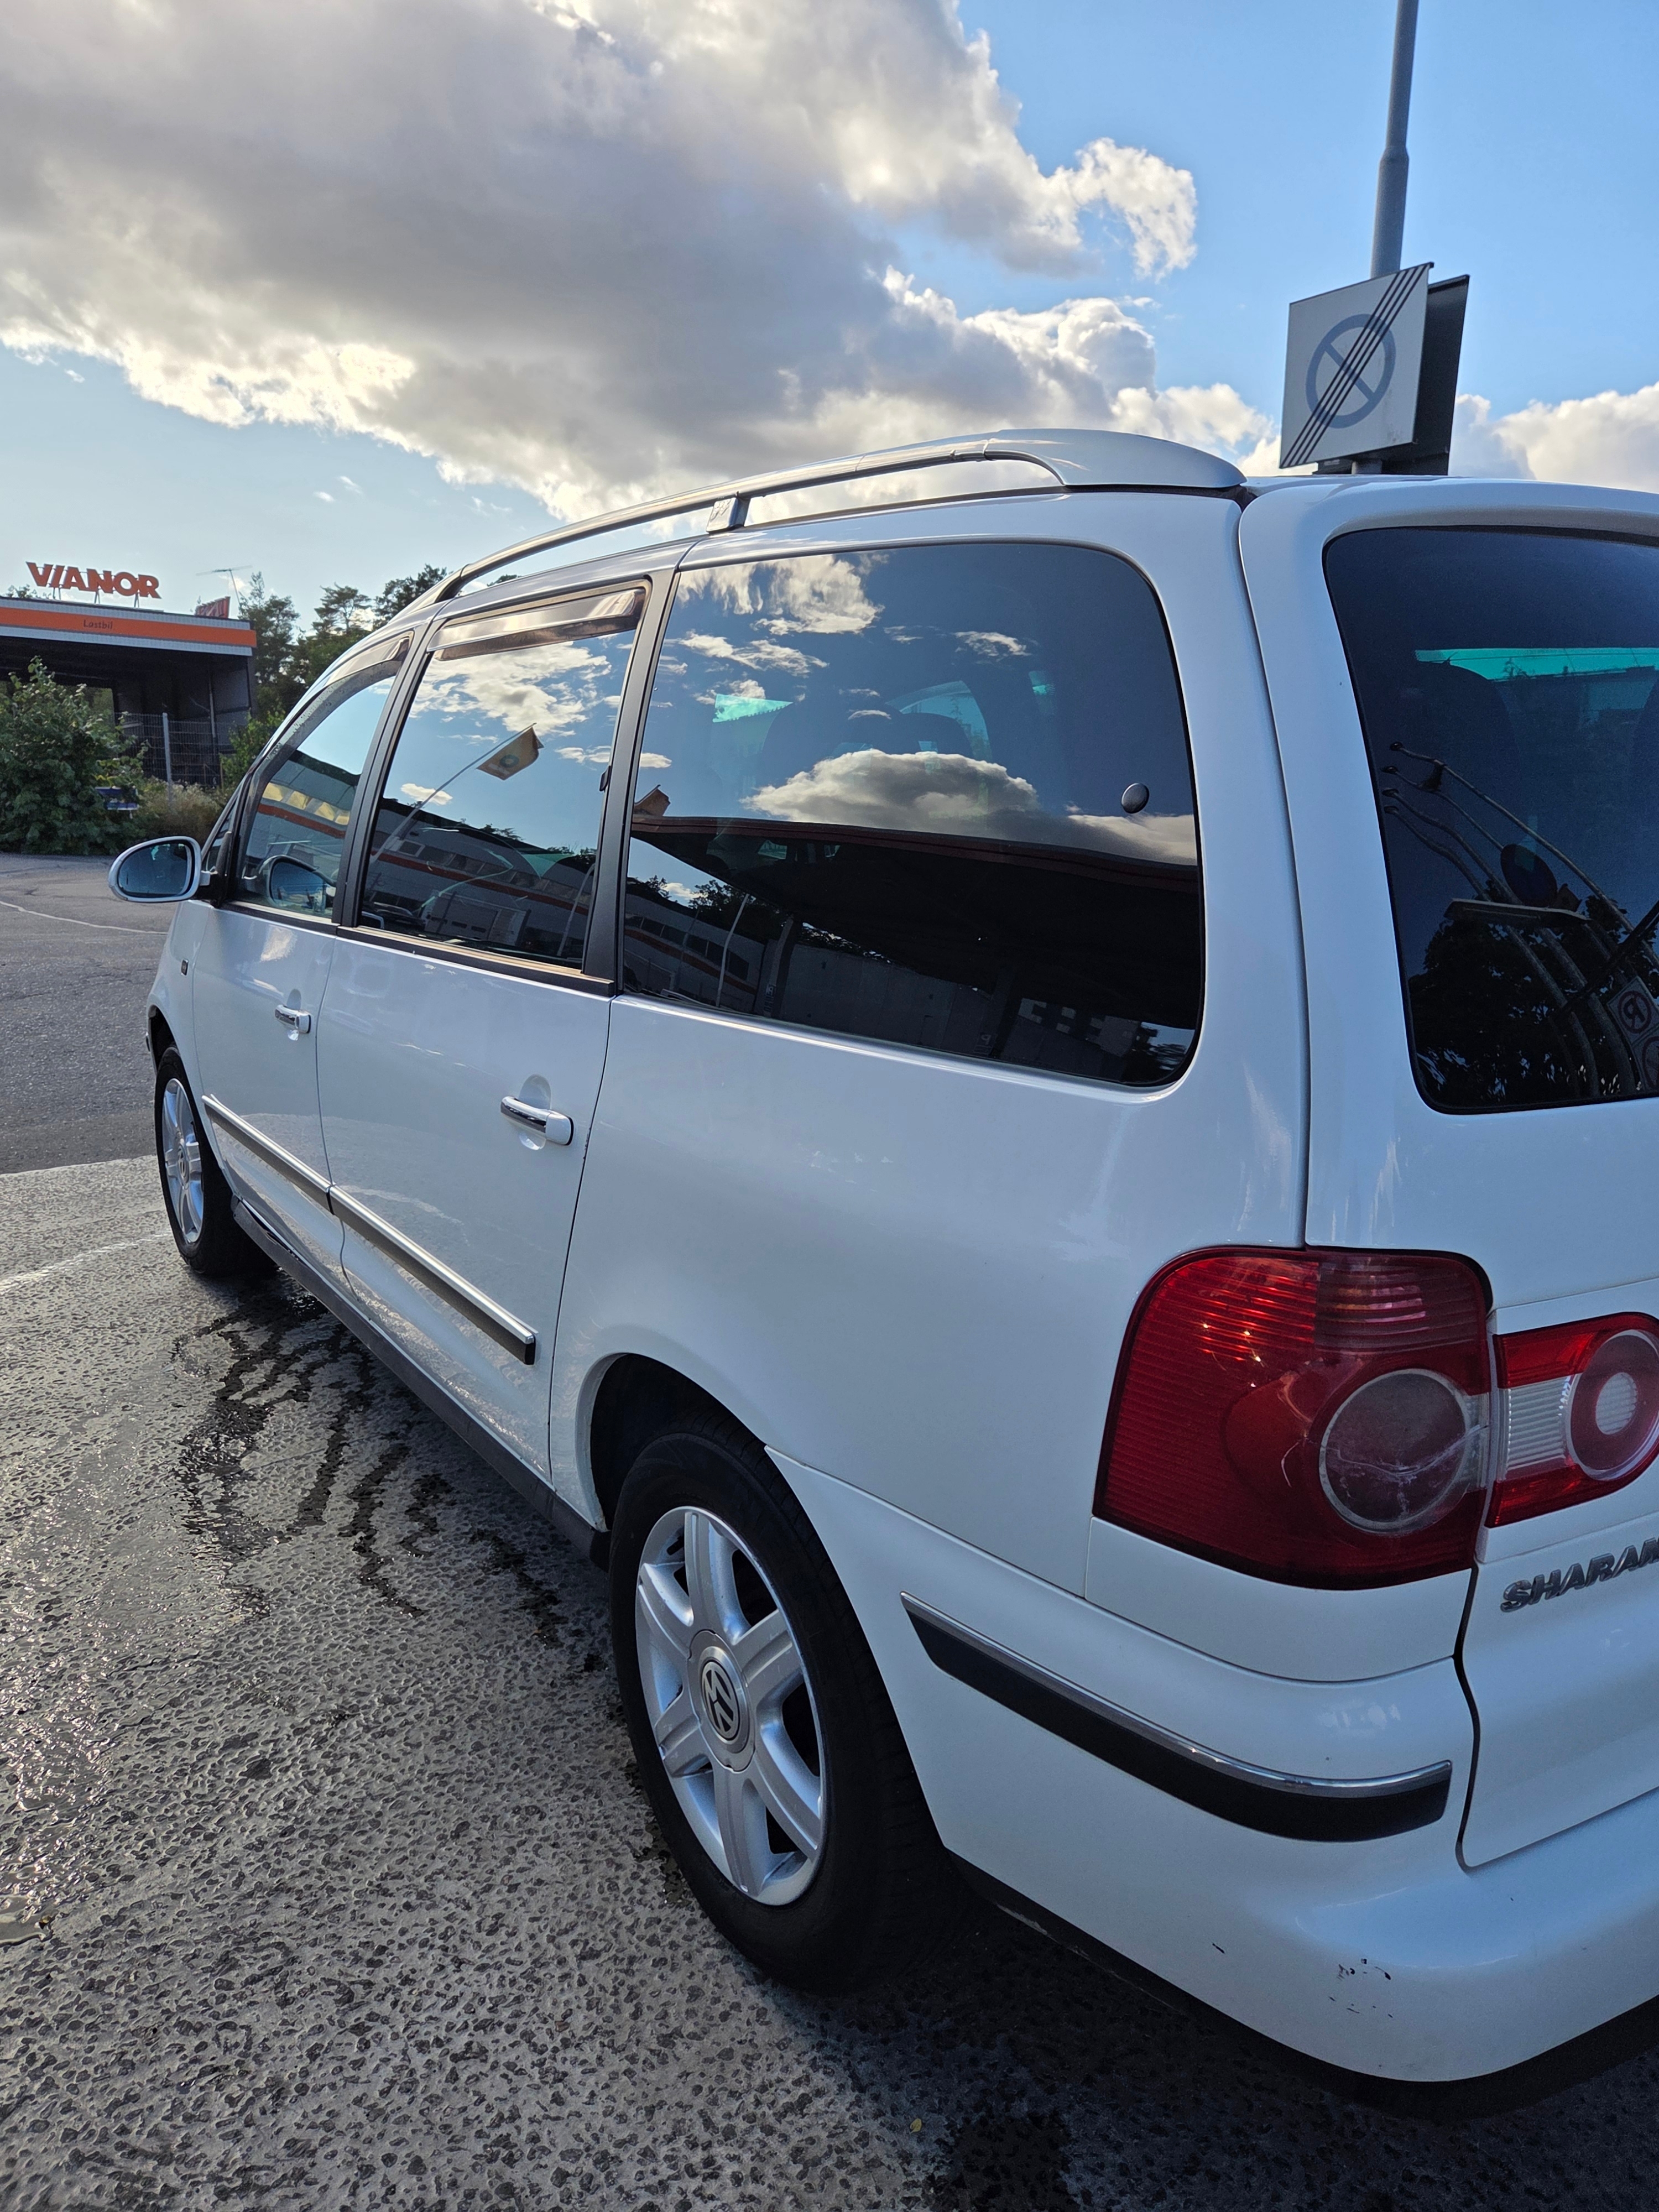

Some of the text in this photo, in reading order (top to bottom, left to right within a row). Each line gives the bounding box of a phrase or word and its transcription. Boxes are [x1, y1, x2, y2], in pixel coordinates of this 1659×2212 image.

[25, 561, 162, 599] VIANOR
[83, 619, 113, 630] Lastbil
[1500, 1536, 1659, 1613] SHARAN
